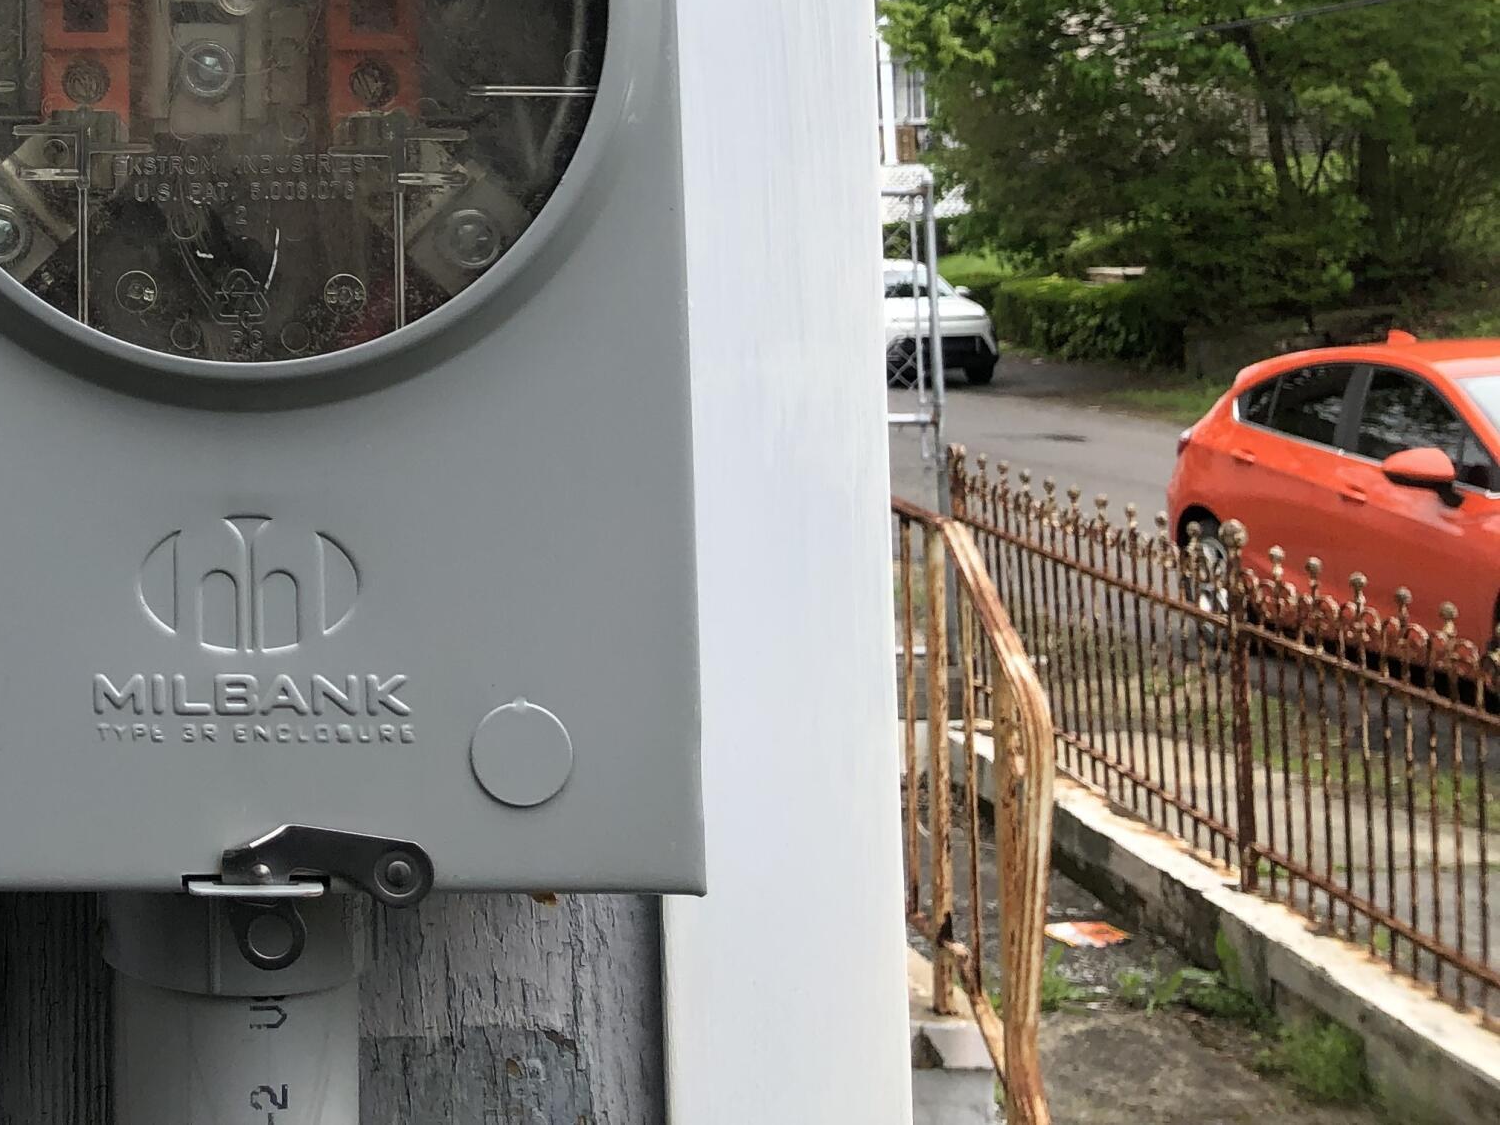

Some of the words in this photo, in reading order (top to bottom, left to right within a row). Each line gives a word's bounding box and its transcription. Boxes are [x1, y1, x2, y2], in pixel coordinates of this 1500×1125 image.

[114, 155, 217, 176] EKSTROM
[237, 154, 366, 174] INDUSTRIES
[134, 182, 178, 202] U.S.
[189, 181, 236, 201] PAT.
[93, 673, 412, 716] MILBANK
[97, 723, 164, 743] TYPE
[182, 723, 217, 743] 3R
[233, 723, 415, 744] ENCLOSURE
